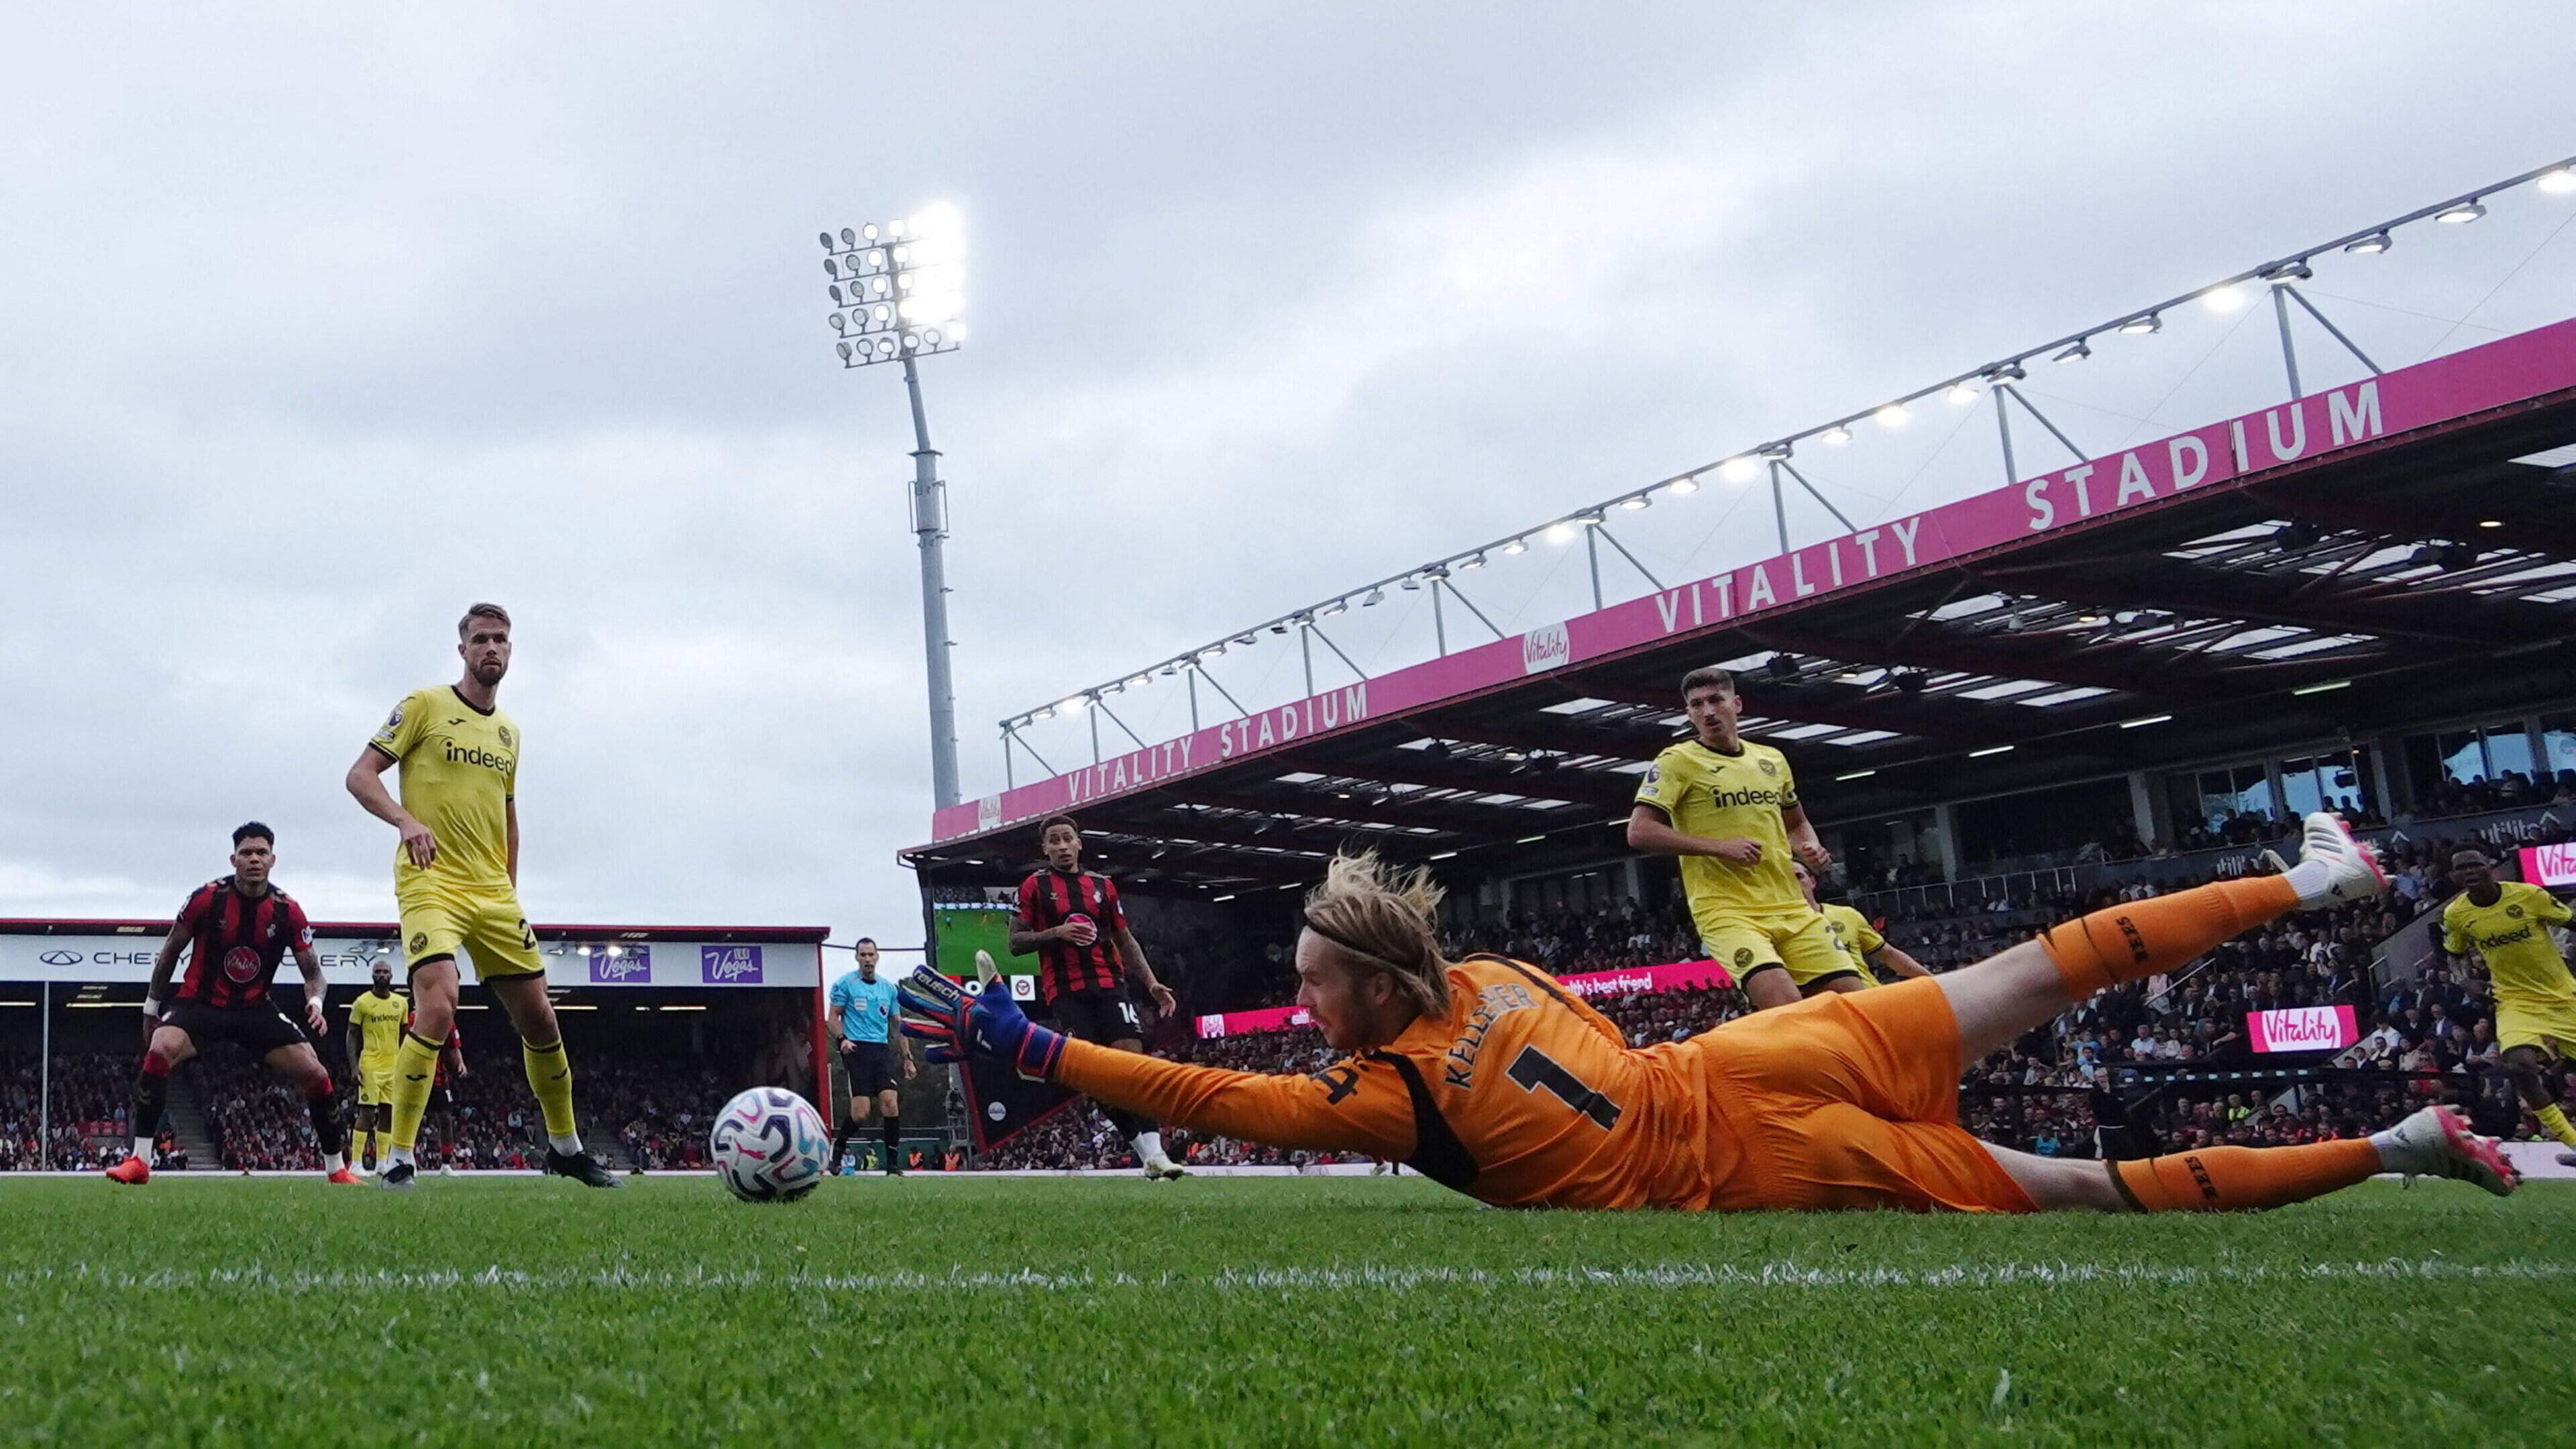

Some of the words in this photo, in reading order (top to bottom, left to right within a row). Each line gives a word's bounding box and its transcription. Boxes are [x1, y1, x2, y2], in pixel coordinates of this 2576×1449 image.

[1654, 517, 1921, 633] VITALITY
[2025, 380, 2383, 531] STADIUM
[1525, 631, 1568, 664] Vitality
[445, 741, 513, 777] indeed
[1067, 736, 1194, 801] VITALITY
[1221, 684, 1368, 757] STADIUM
[93, 952, 192, 965] CHEY
[281, 955, 376, 967] CERY
[705, 950, 759, 981] Vegas
[2265, 1009, 2337, 1049] Vitality
[1505, 1044, 1623, 1132] 1
